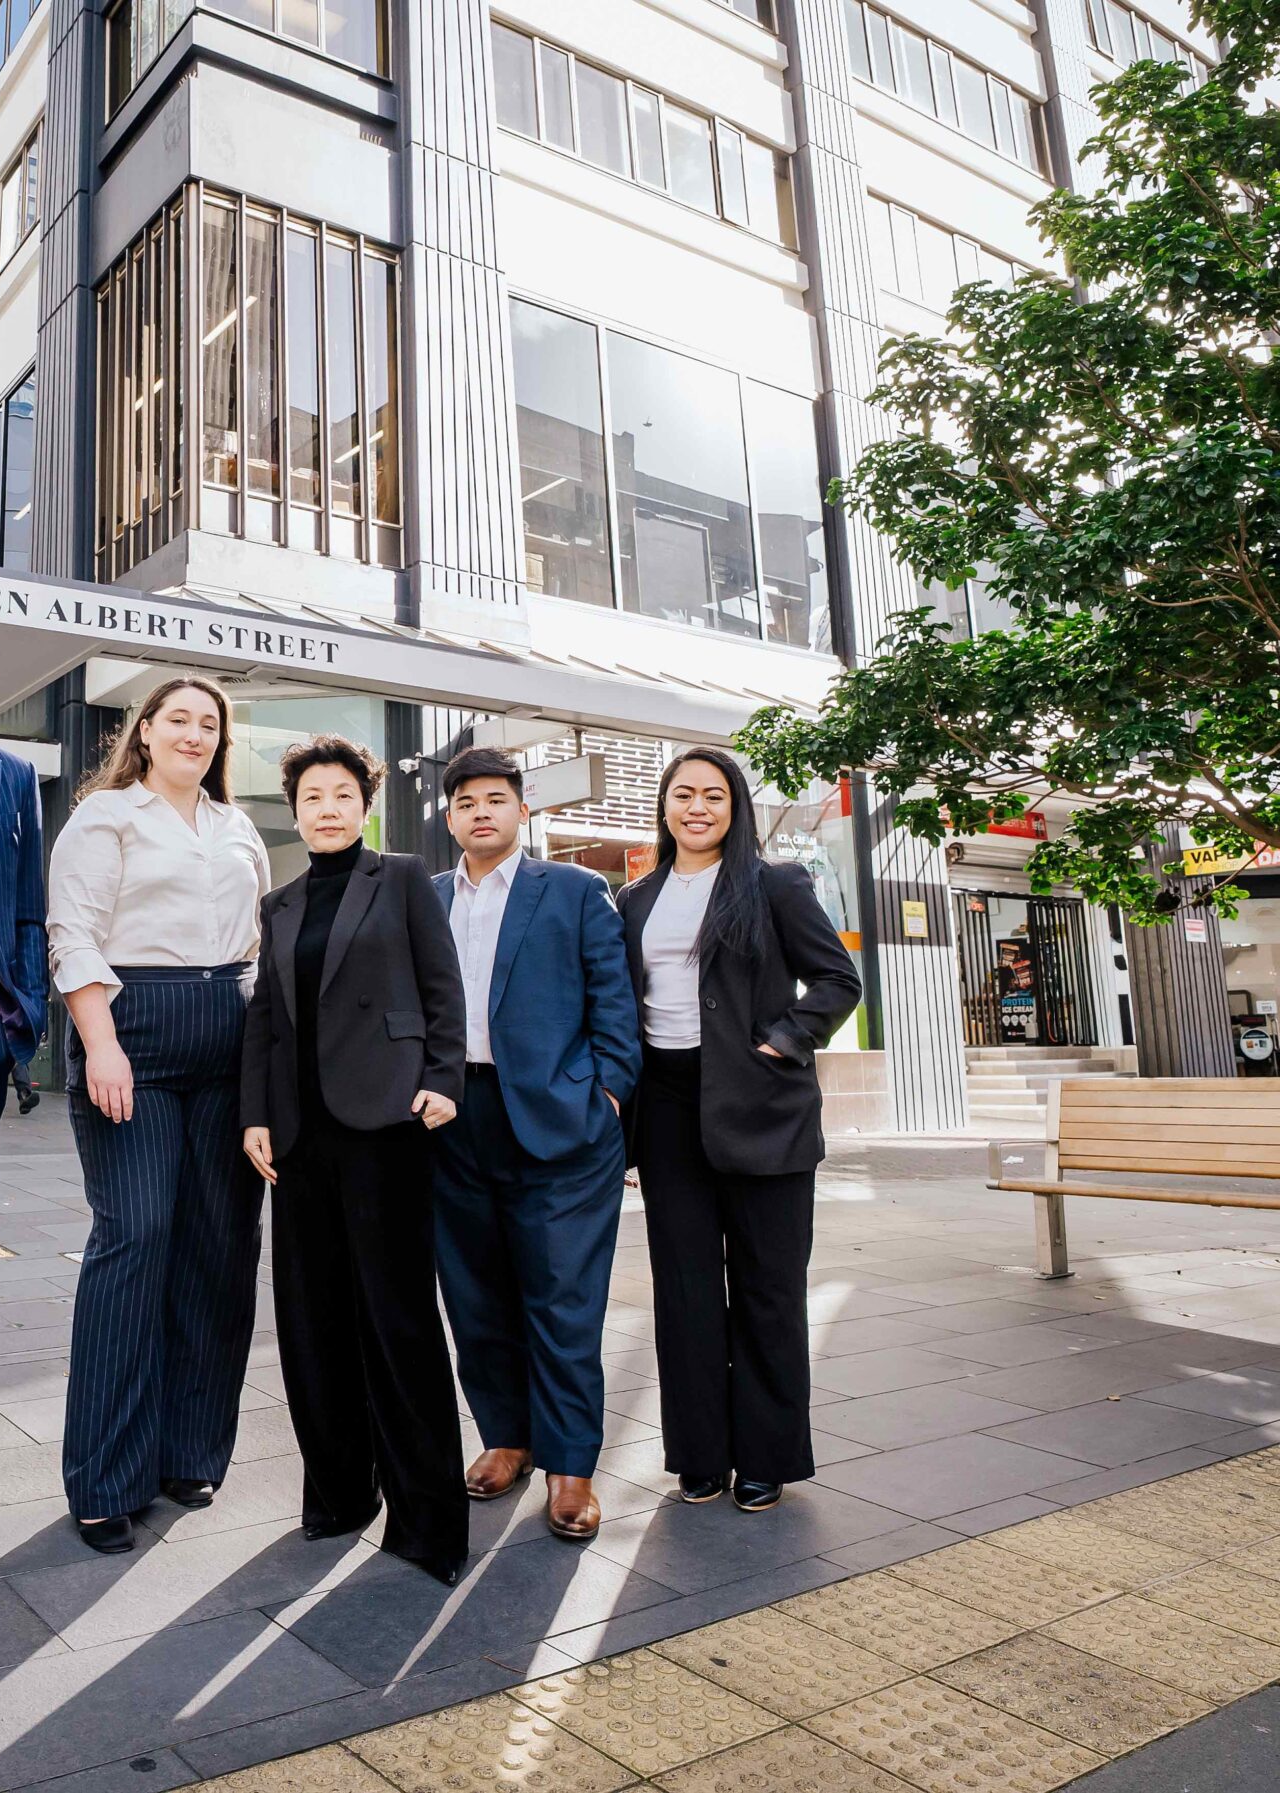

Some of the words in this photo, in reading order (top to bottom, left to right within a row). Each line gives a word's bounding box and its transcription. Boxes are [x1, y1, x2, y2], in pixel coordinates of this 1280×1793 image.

[45, 598, 194, 640] ALBERT
[207, 624, 339, 663] STREET
[1002, 998, 1035, 1006] PROTEIN
